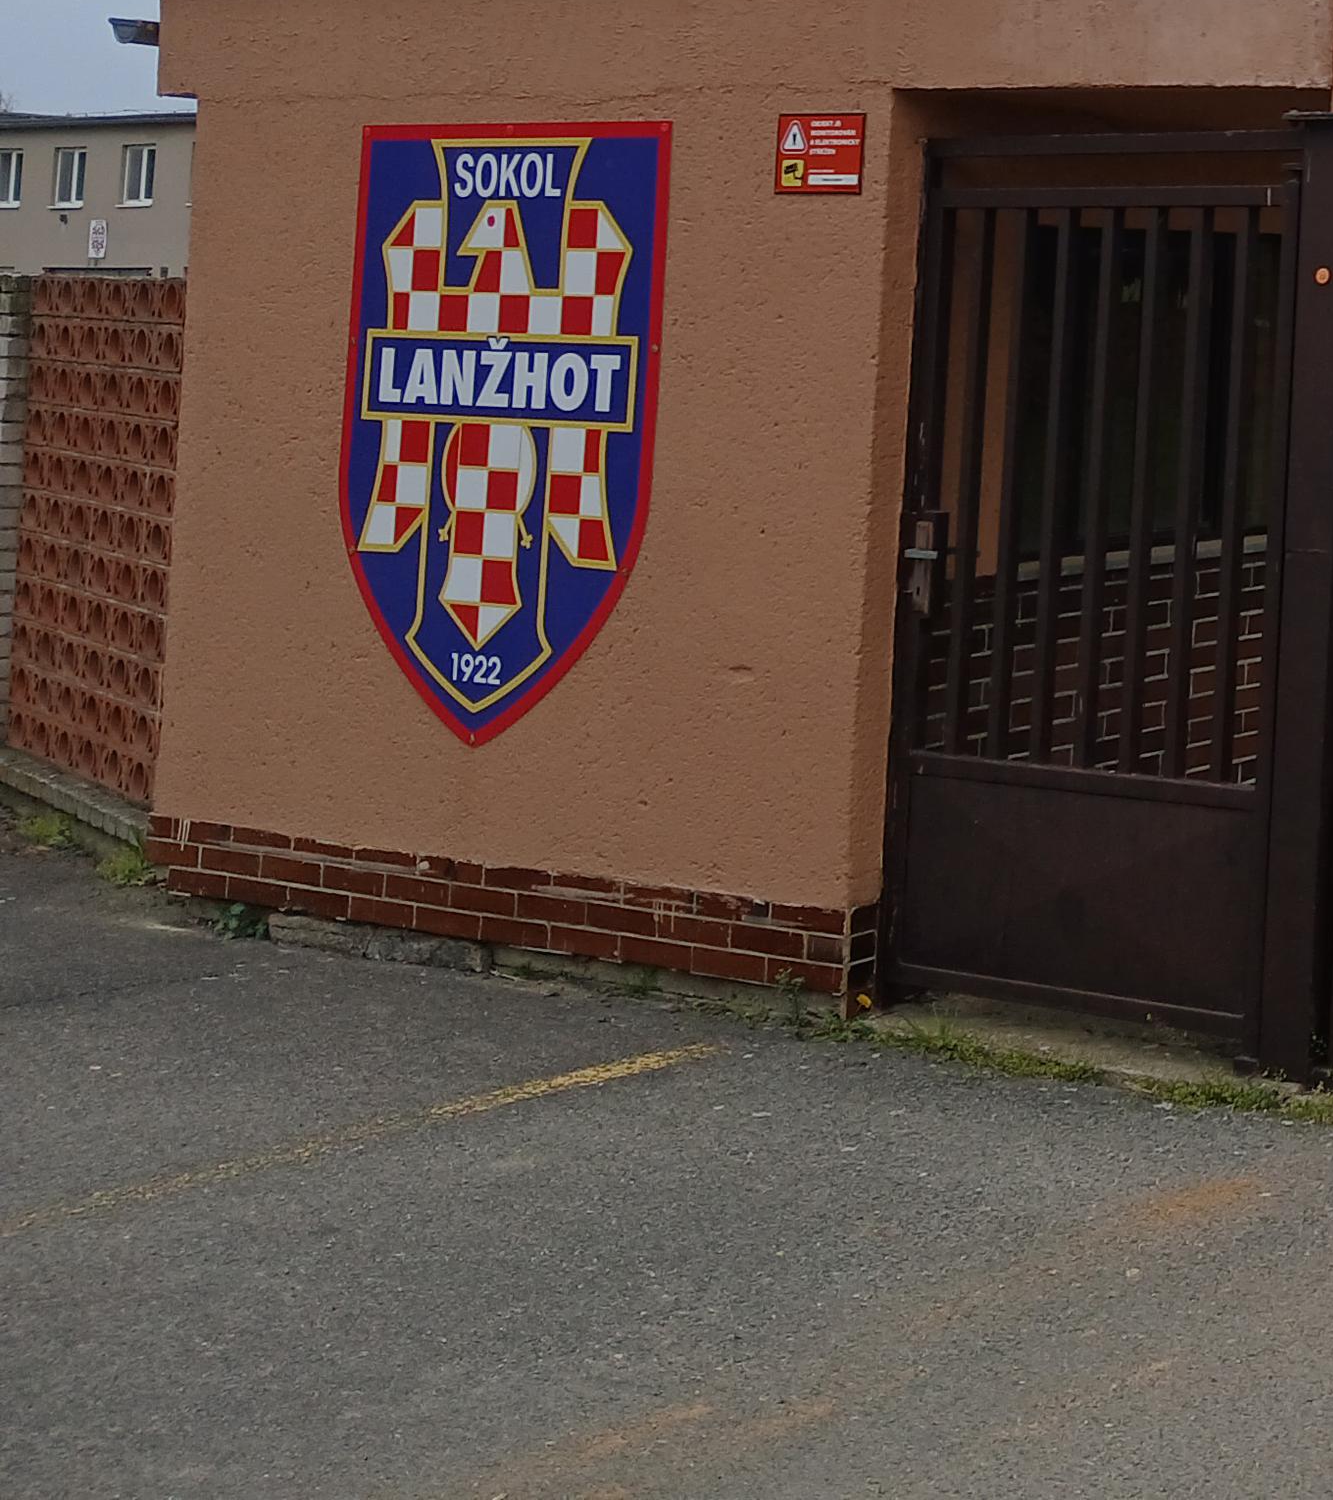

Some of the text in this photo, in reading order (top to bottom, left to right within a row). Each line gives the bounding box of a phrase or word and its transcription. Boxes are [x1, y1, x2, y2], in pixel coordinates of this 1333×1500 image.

[454, 152, 562, 199] SOKOL
[377, 336, 621, 413] LANŽHOT
[450, 651, 502, 686] 1922
